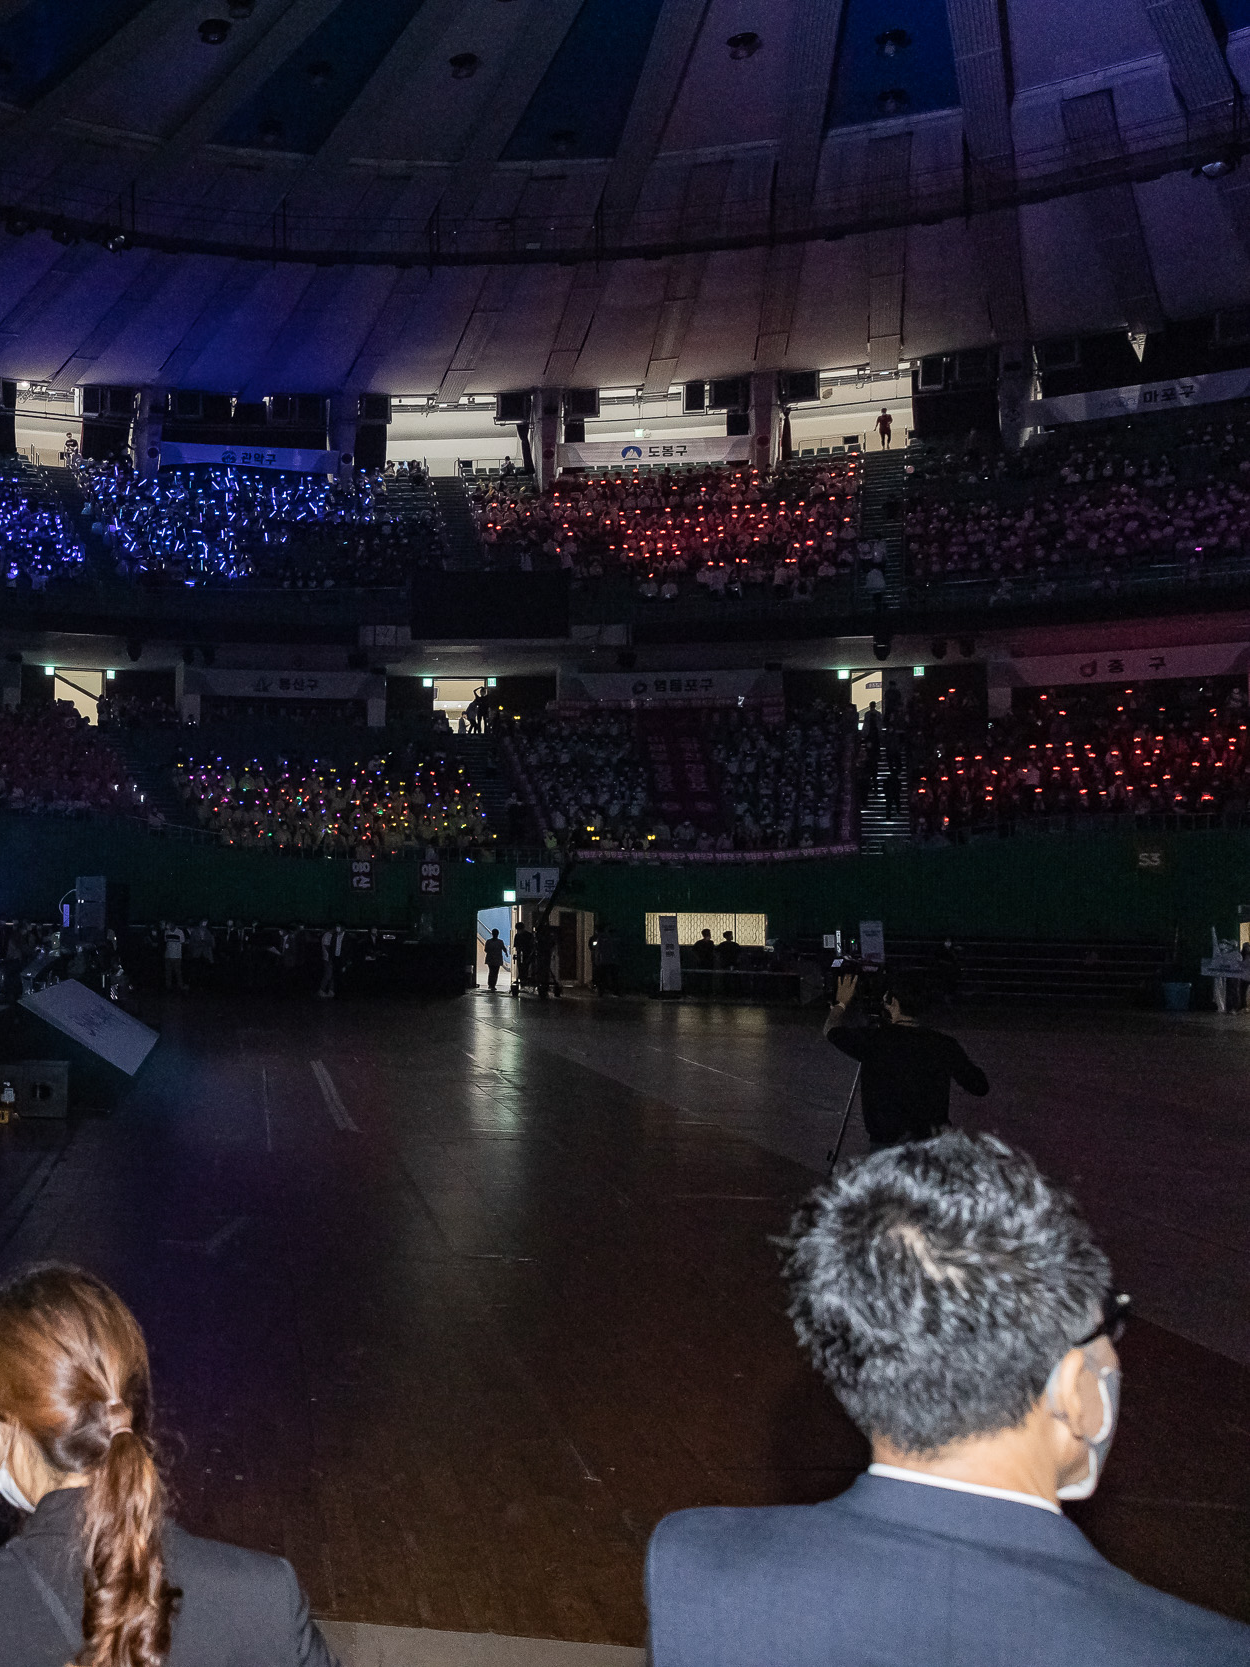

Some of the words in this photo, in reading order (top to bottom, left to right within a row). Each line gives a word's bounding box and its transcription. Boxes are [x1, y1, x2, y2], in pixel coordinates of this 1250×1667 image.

[1143, 385, 1195, 403] 마포구
[648, 445, 688, 458] 도봉구
[241, 452, 277, 465] 관악구
[278, 678, 319, 691] 용산구
[653, 678, 714, 692] 영등포구
[1138, 853, 1161, 866] S3
